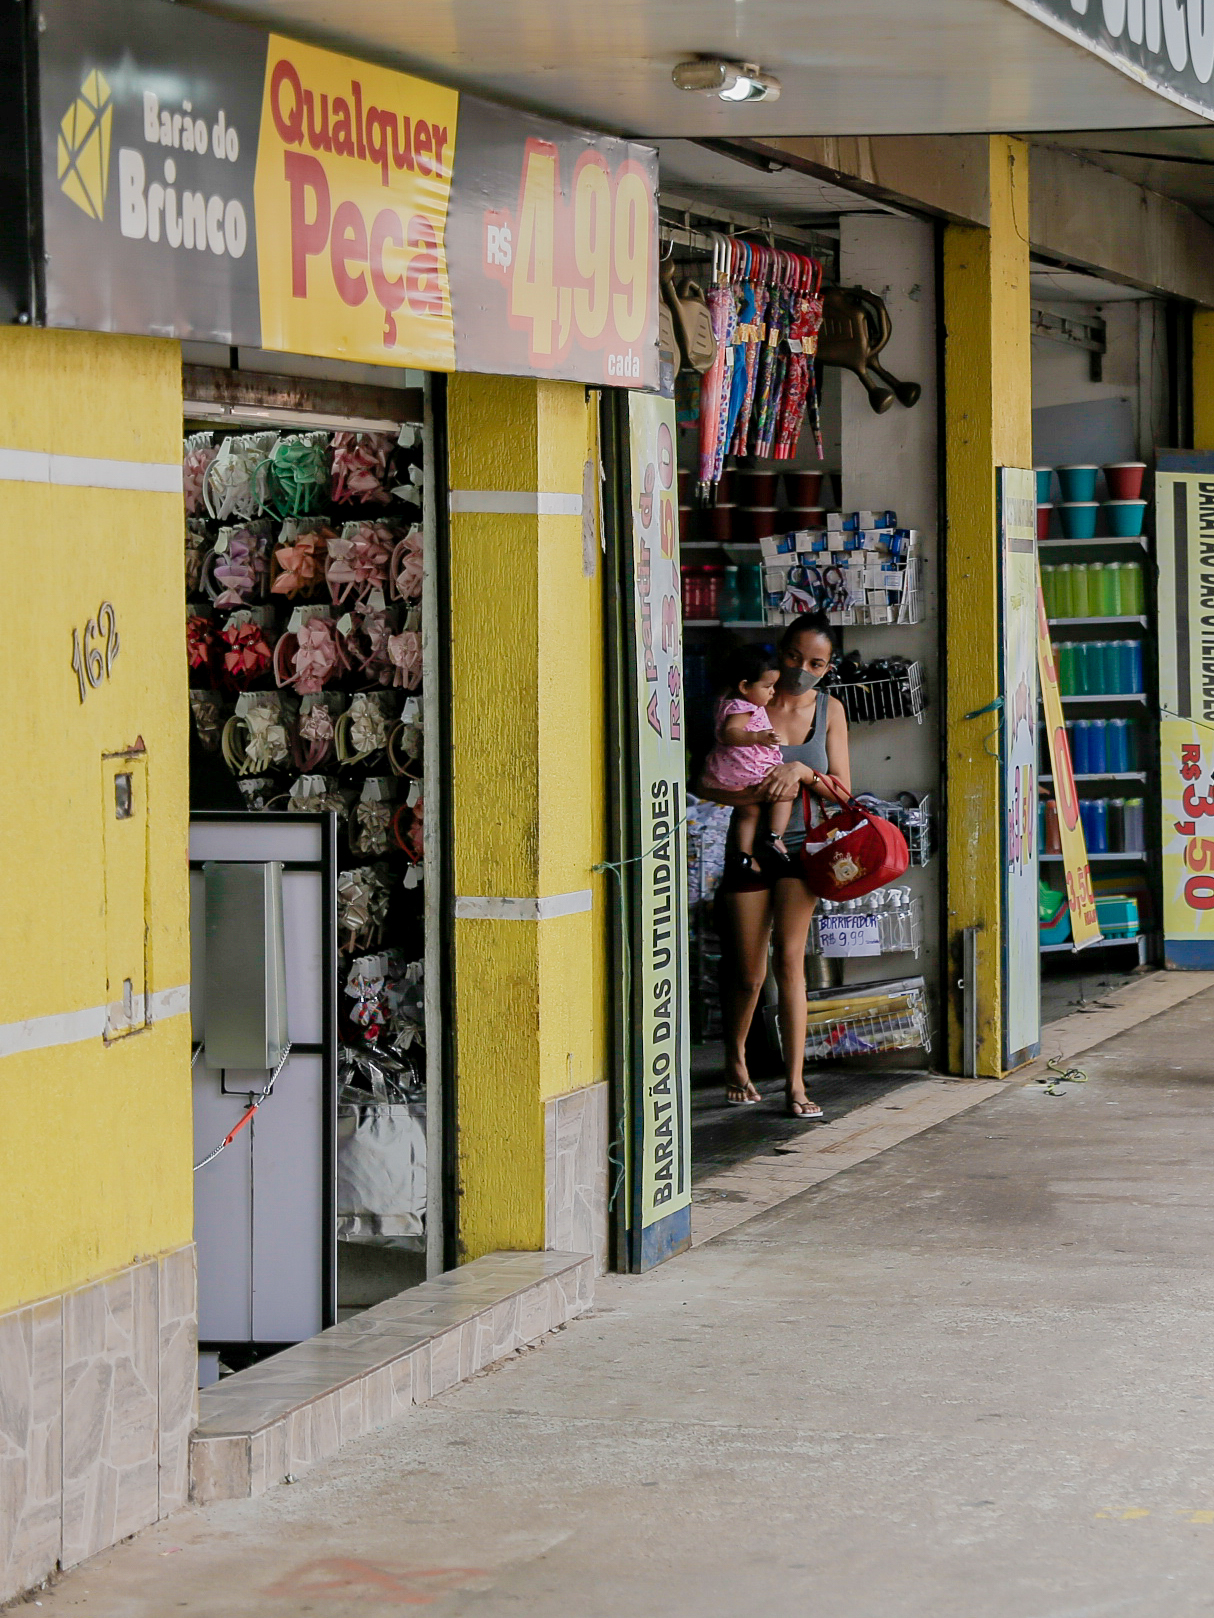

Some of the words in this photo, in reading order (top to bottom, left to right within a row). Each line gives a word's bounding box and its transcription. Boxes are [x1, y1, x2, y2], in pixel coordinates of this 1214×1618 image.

[143, 91, 208, 154] Barão
[212, 108, 239, 162] do
[271, 59, 448, 187] Qualquer
[119, 147, 247, 259] Brinco
[283, 150, 444, 349] Peça
[486, 221, 512, 273] R$
[512, 146, 652, 357] 4,99
[607, 350, 640, 378] cada
[657, 422, 680, 655] 3,50
[71, 600, 119, 704] 162
[637, 538, 657, 682] partir
[668, 664, 681, 741] R$
[1179, 743, 1202, 781] R$
[651, 779, 672, 970] UTILIDADES
[652, 977, 672, 1043] DAS
[649, 1056, 673, 1208] BARATÃO
